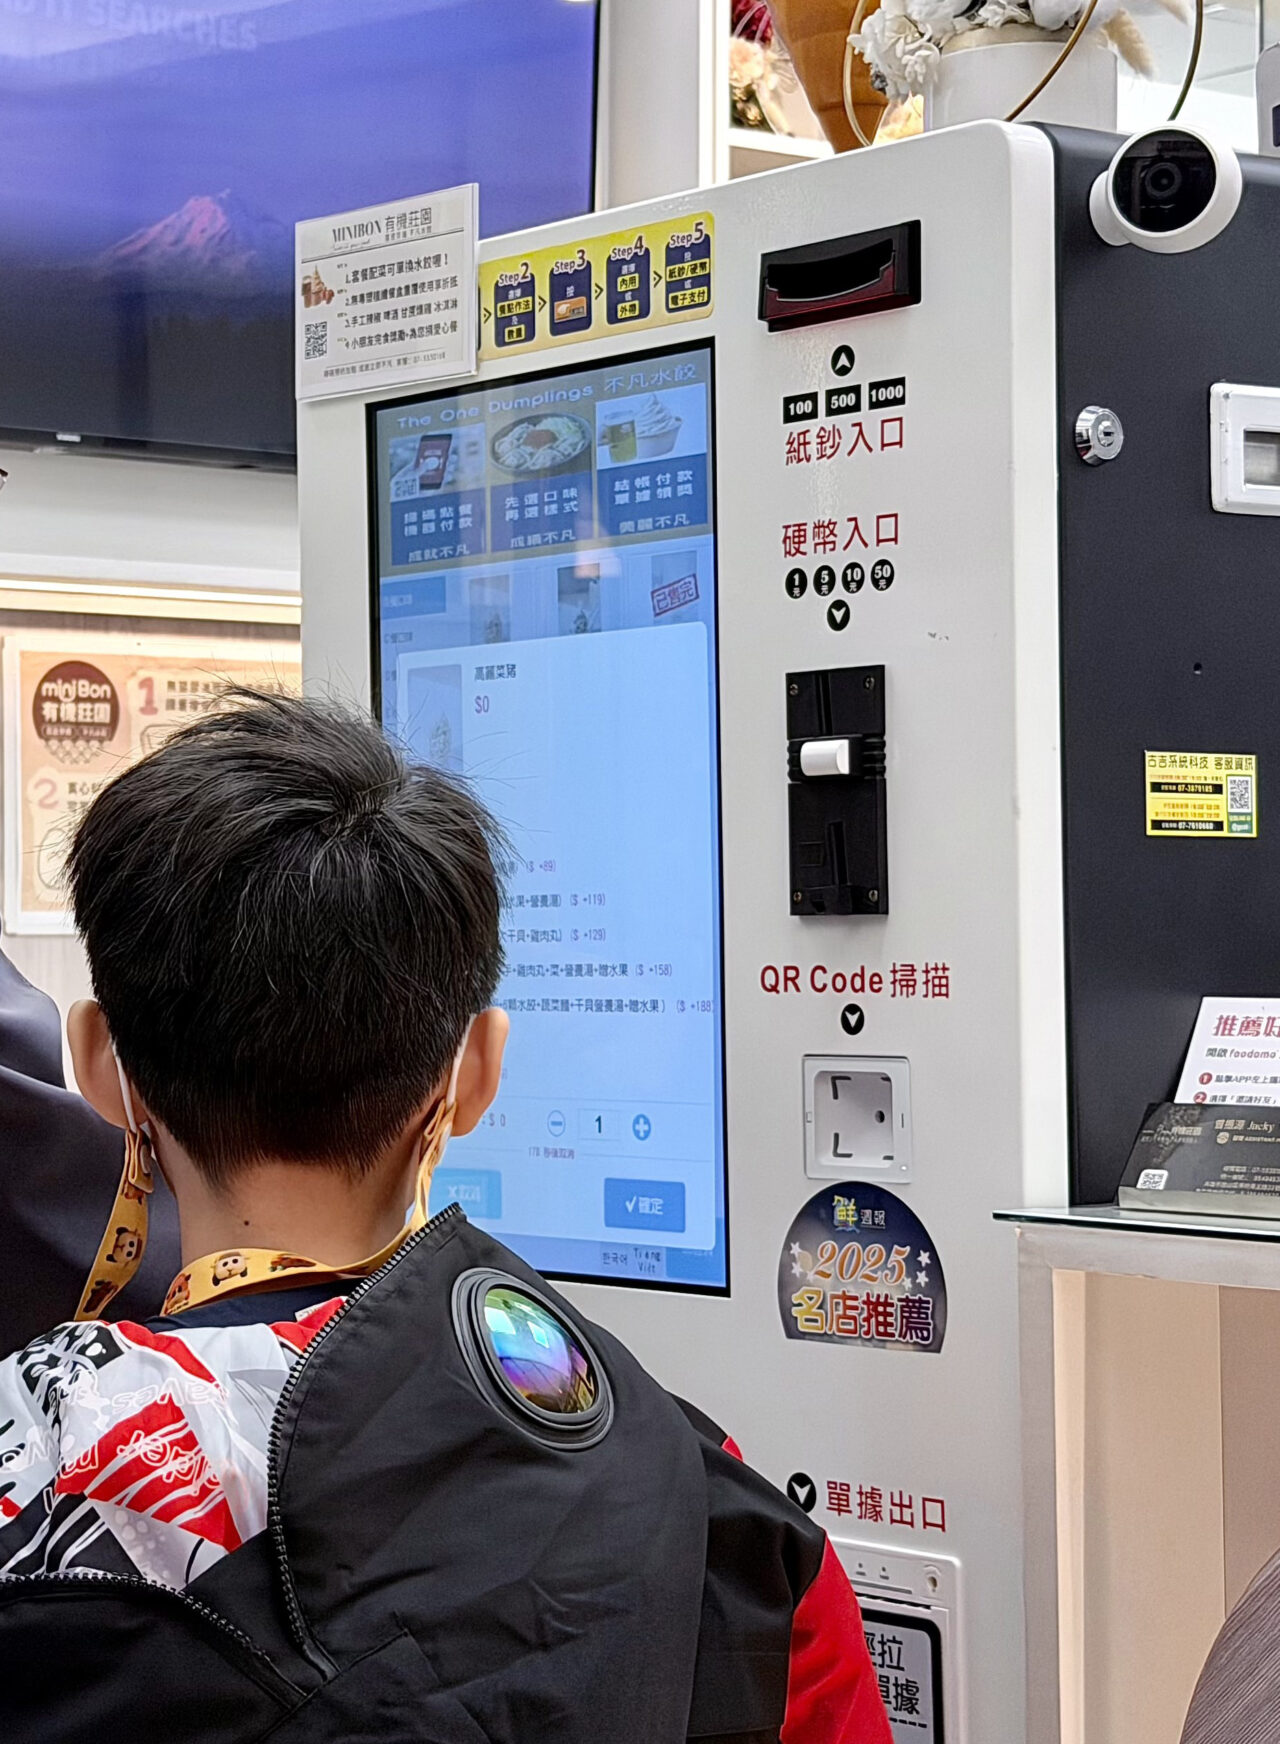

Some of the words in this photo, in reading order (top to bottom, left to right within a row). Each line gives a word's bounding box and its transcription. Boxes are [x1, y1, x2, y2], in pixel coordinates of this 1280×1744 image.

[86, 1, 258, 51] SEARCHES
[384, 207, 432, 233] 有機莊園
[668, 261, 708, 279] 紙鈔/硬幣
[619, 276, 638, 290] 內用
[498, 298, 532, 316] 餐點作法
[670, 288, 707, 307] 電子支付
[619, 303, 638, 318] 外帶
[506, 326, 524, 340] 數量
[397, 415, 432, 430] The
[439, 405, 480, 424] One
[488, 383, 594, 414] Dumplings
[603, 363, 697, 393] 不凡水餃
[830, 392, 857, 409] 500
[870, 384, 905, 402] 1000
[788, 399, 813, 416] 100
[785, 416, 904, 466] 紙鈔入口
[613, 470, 693, 493] 結帳付款
[504, 487, 579, 510] 先選口味
[505, 500, 580, 522] 再選樣式
[781, 513, 900, 559] 硬幣入口
[792, 572, 800, 587] 1
[820, 570, 830, 585] 5
[845, 567, 862, 583] 10
[873, 564, 892, 580] 50
[792, 586, 801, 597] 元
[820, 584, 830, 595] 元
[849, 582, 858, 593] 元
[878, 579, 887, 591] 元
[655, 580, 694, 611] 已售完
[41, 678, 112, 703] miniBon
[137, 677, 159, 716] 1
[41, 701, 111, 724] 有機莊園
[474, 695, 490, 715] $0
[34, 777, 60, 810] 2
[760, 965, 801, 994] QR
[810, 965, 883, 993] Code
[889, 962, 951, 999] 掃描
[594, 1115, 603, 1134] 1
[638, 1196, 665, 1216] 確定
[812, 1240, 911, 1286] 2025
[791, 1286, 933, 1345] 名店推薦
[826, 1480, 947, 1532] 單據出口
